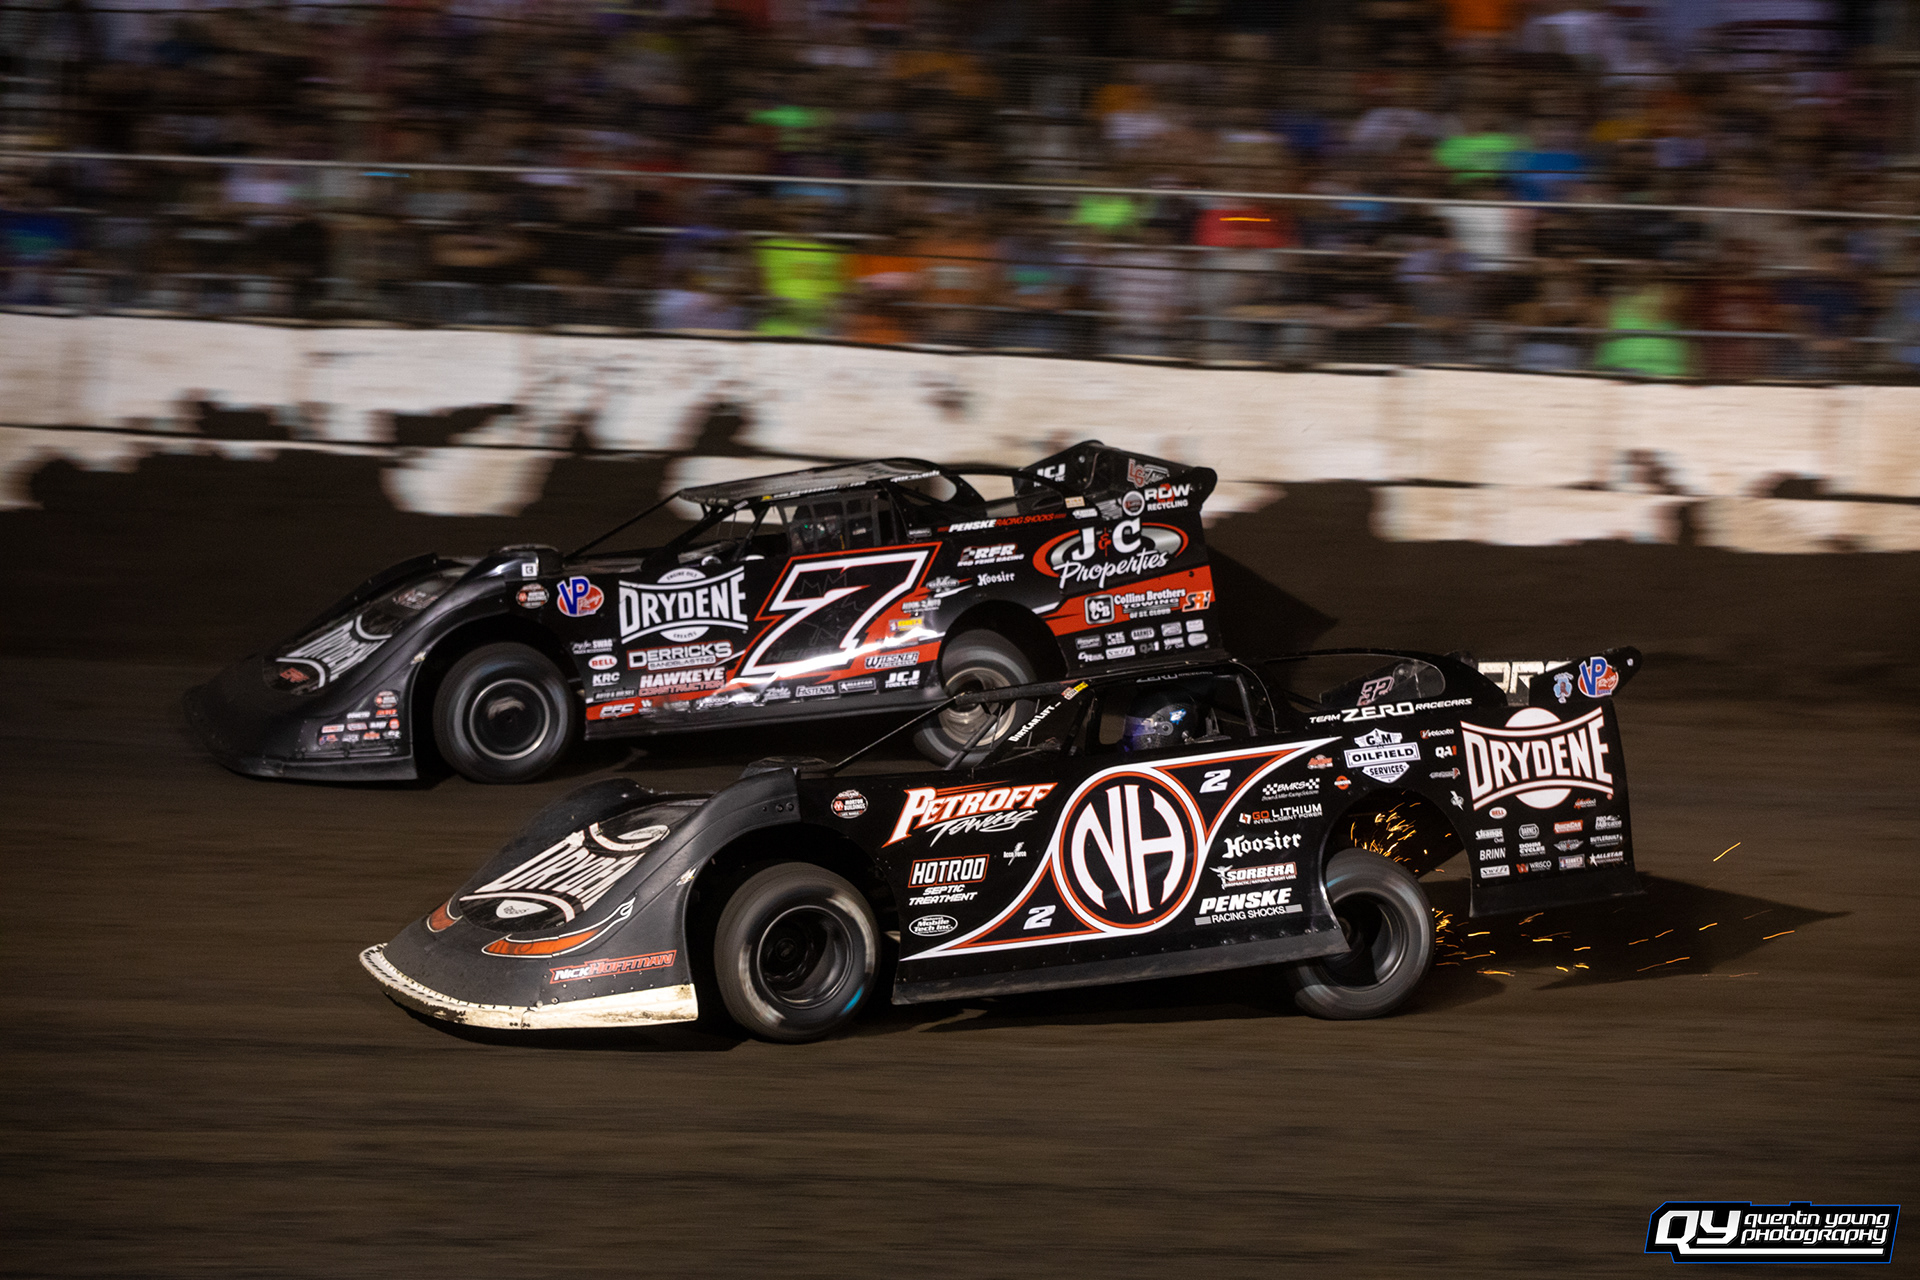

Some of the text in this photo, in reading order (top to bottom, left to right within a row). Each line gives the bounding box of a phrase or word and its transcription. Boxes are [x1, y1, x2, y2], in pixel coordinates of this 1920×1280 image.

[1147, 499, 1188, 511] RECYCLING
[949, 519, 996, 532] PENSKE
[1023, 513, 1054, 523] SHOCKS
[1072, 527, 1095, 560] J
[1113, 518, 1141, 553] C
[974, 544, 1016, 559] RFR
[1053, 548, 1168, 588] Properties
[977, 571, 1015, 586] Hoosier
[559, 578, 589, 614] VP
[619, 572, 748, 637] DRYDENE
[1114, 588, 1186, 605] Collins Brothers
[1122, 598, 1179, 609] TOWING
[740, 549, 930, 677] 7
[592, 658, 614, 667] BELL
[629, 642, 732, 668] DERRICK'S
[649, 657, 714, 668] SANDBLASTING
[866, 652, 919, 668] WIESNER
[592, 672, 620, 683] KRC
[640, 667, 725, 688] HAWKEYE
[885, 670, 920, 683] JCJ
[1581, 658, 1606, 695] VP
[639, 680, 724, 697] CONSTRUCTION
[1309, 698, 1473, 723] TEAM ZERO RACECARS
[1352, 748, 1414, 762] OILFIELD
[1435, 745, 1457, 758] QA1
[1462, 715, 1613, 800] DRYDENE
[1370, 764, 1404, 776] SERVICES
[1199, 769, 1231, 793] 2
[1276, 781, 1306, 792] BMRS
[882, 782, 1058, 848] PETROFF
[1252, 803, 1322, 820] GO LITHIUM
[1254, 811, 1323, 824] INTELLIGENT POWER
[926, 810, 1038, 847] Towing
[1071, 784, 1186, 914] NH
[1222, 830, 1302, 858] Hoosier
[1479, 847, 1506, 861] BRINN
[1596, 851, 1623, 859] ALLSTAR
[912, 857, 986, 885] HOTROD
[1227, 863, 1295, 881] SORBERA
[923, 884, 965, 896] SEPTIC
[909, 892, 978, 906] TREATMENT
[1199, 887, 1292, 914] PENSKE
[917, 919, 949, 927] Mobile
[1023, 905, 1056, 930] 2
[1212, 911, 1246, 924] RACING
[554, 954, 673, 981] NICK HOFFMAN
